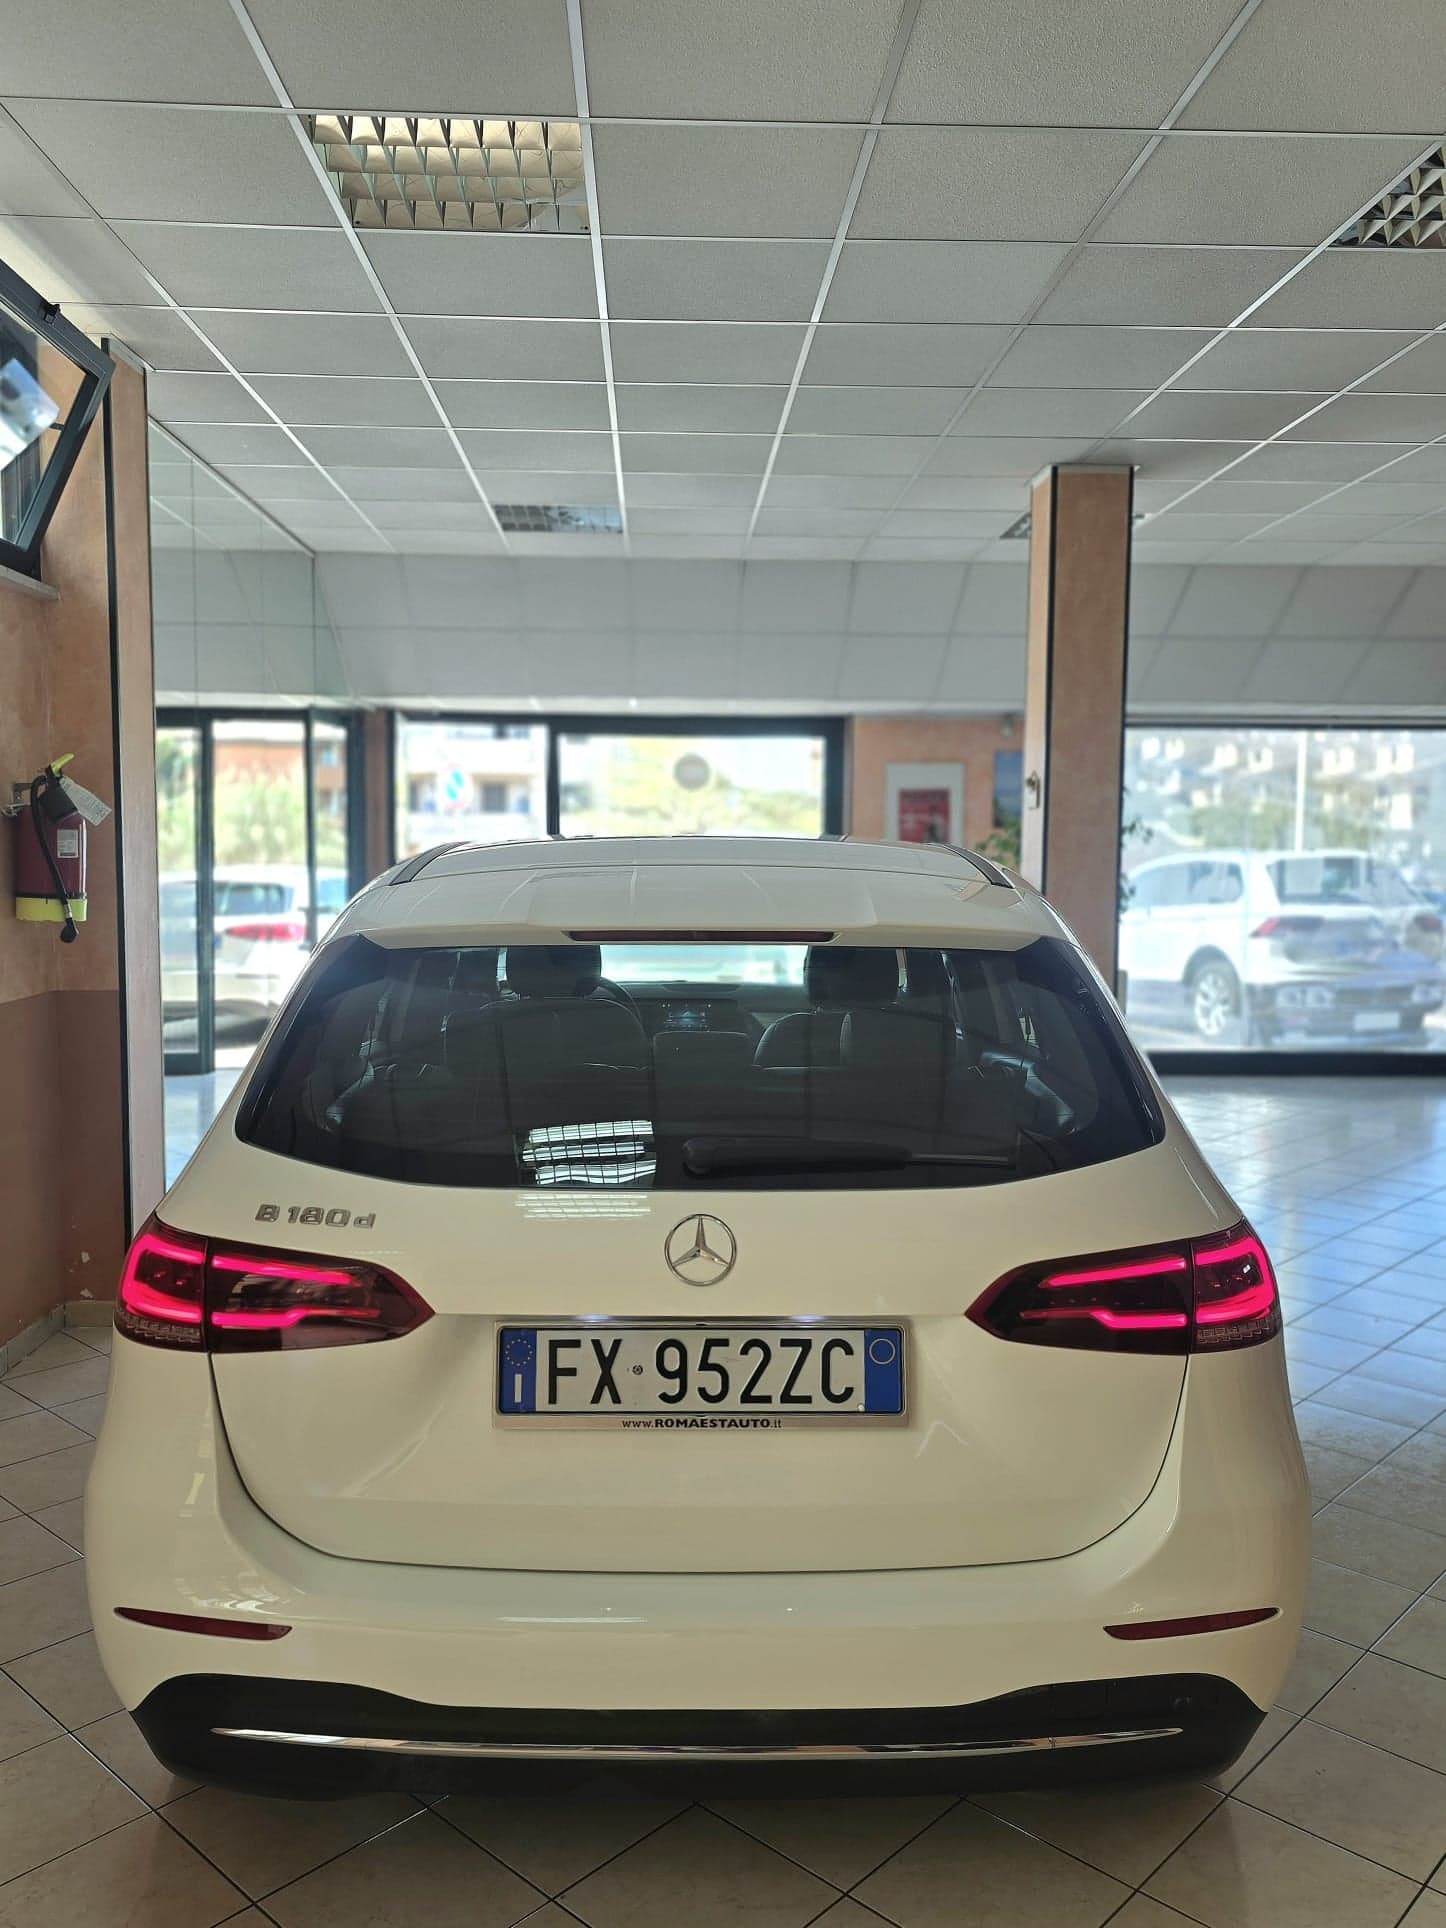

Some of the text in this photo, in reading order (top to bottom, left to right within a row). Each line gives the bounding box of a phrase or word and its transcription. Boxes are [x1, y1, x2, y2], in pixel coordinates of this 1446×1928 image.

[255, 1203, 281, 1223] B
[548, 1338, 623, 1405] FX
[655, 1338, 855, 1405] 952ZC
[621, 1418, 783, 1429] www.ROMAESTAUTO.it
